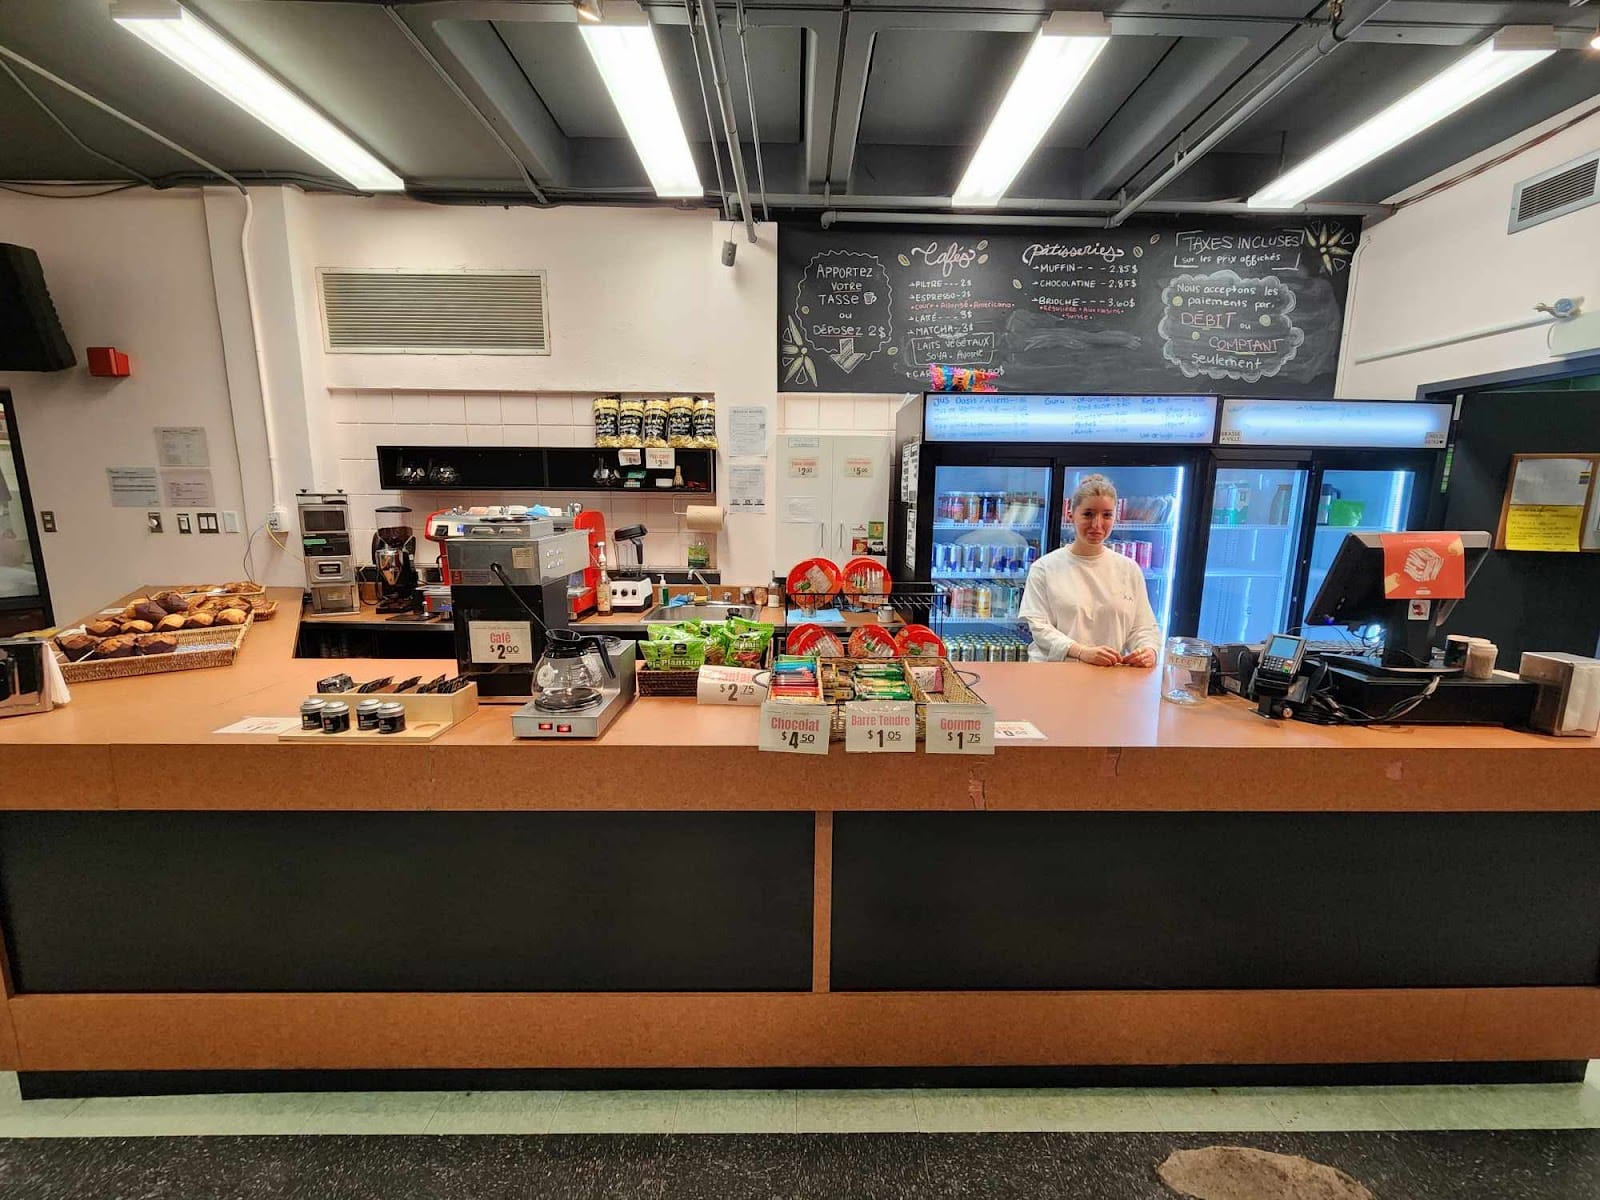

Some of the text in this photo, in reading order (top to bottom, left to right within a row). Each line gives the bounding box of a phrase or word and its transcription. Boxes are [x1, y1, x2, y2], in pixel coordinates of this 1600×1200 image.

[1182, 235, 1300, 254] TAXES INCLUSES
[911, 242, 976, 277] Cafés
[1200, 255, 1211, 263] les
[1216, 255, 1237, 264] prix
[1240, 253, 1281, 267] affichés
[1040, 263, 1075, 273] MUFFIN
[1040, 280, 1096, 288] CHOCOLATINE
[1177, 283, 1279, 297] Nous acceptons les
[1038, 296, 1080, 306] BRIOCHE
[1188, 297, 1248, 307] paiements
[1181, 310, 1237, 328] DÉBIT
[915, 325, 953, 336] MATCHA
[917, 341, 940, 350] LAITS
[1209, 336, 1285, 352] COMPTANT
[490, 631, 511, 644] Café
[771, 716, 820, 732] Chocolat
[851, 715, 911, 726] Barre Tendre
[940, 718, 981, 731] Gomme
